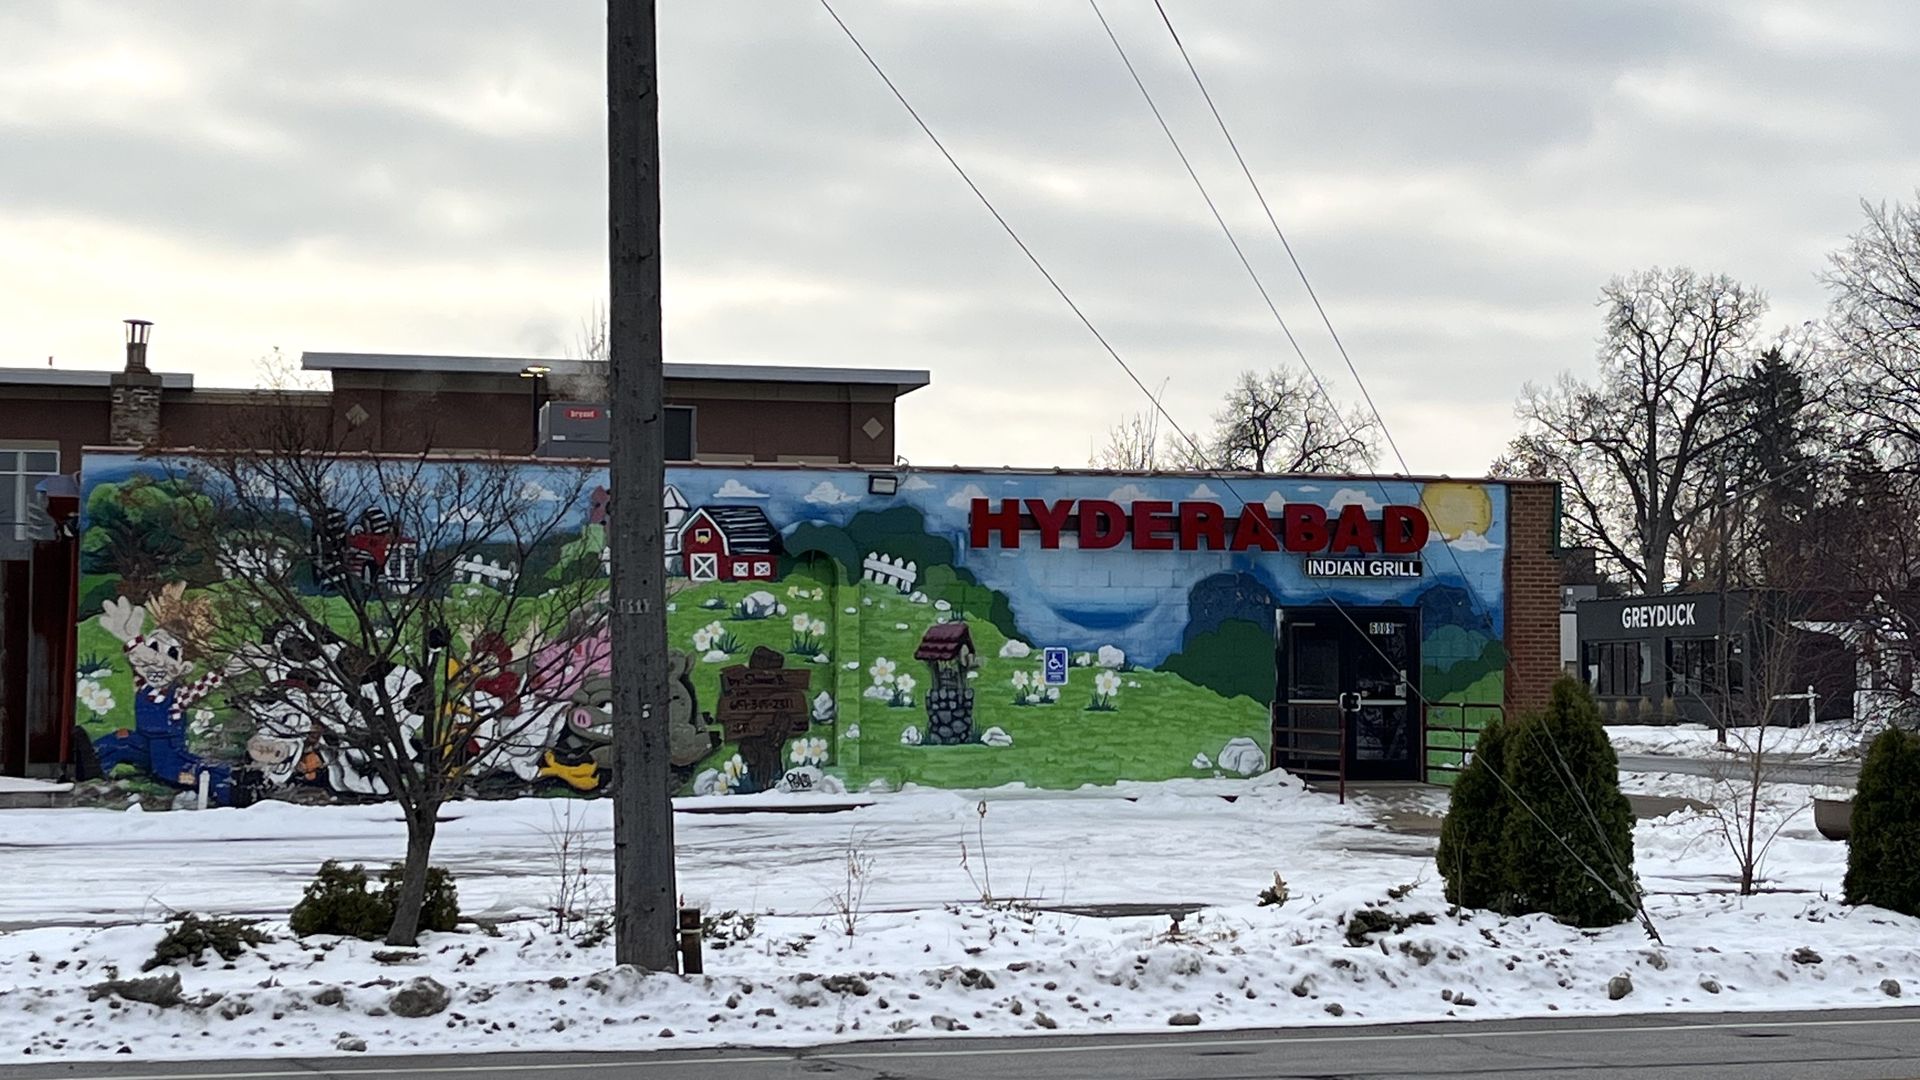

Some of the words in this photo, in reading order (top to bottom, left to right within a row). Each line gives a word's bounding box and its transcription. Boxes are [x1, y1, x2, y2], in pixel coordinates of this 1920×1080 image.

[970, 498, 1429, 553] HYDERABAD
[1308, 560, 1365, 575] INDIAN
[1369, 561, 1420, 576] GRILL
[1622, 603, 1696, 628] GREYDUCK
